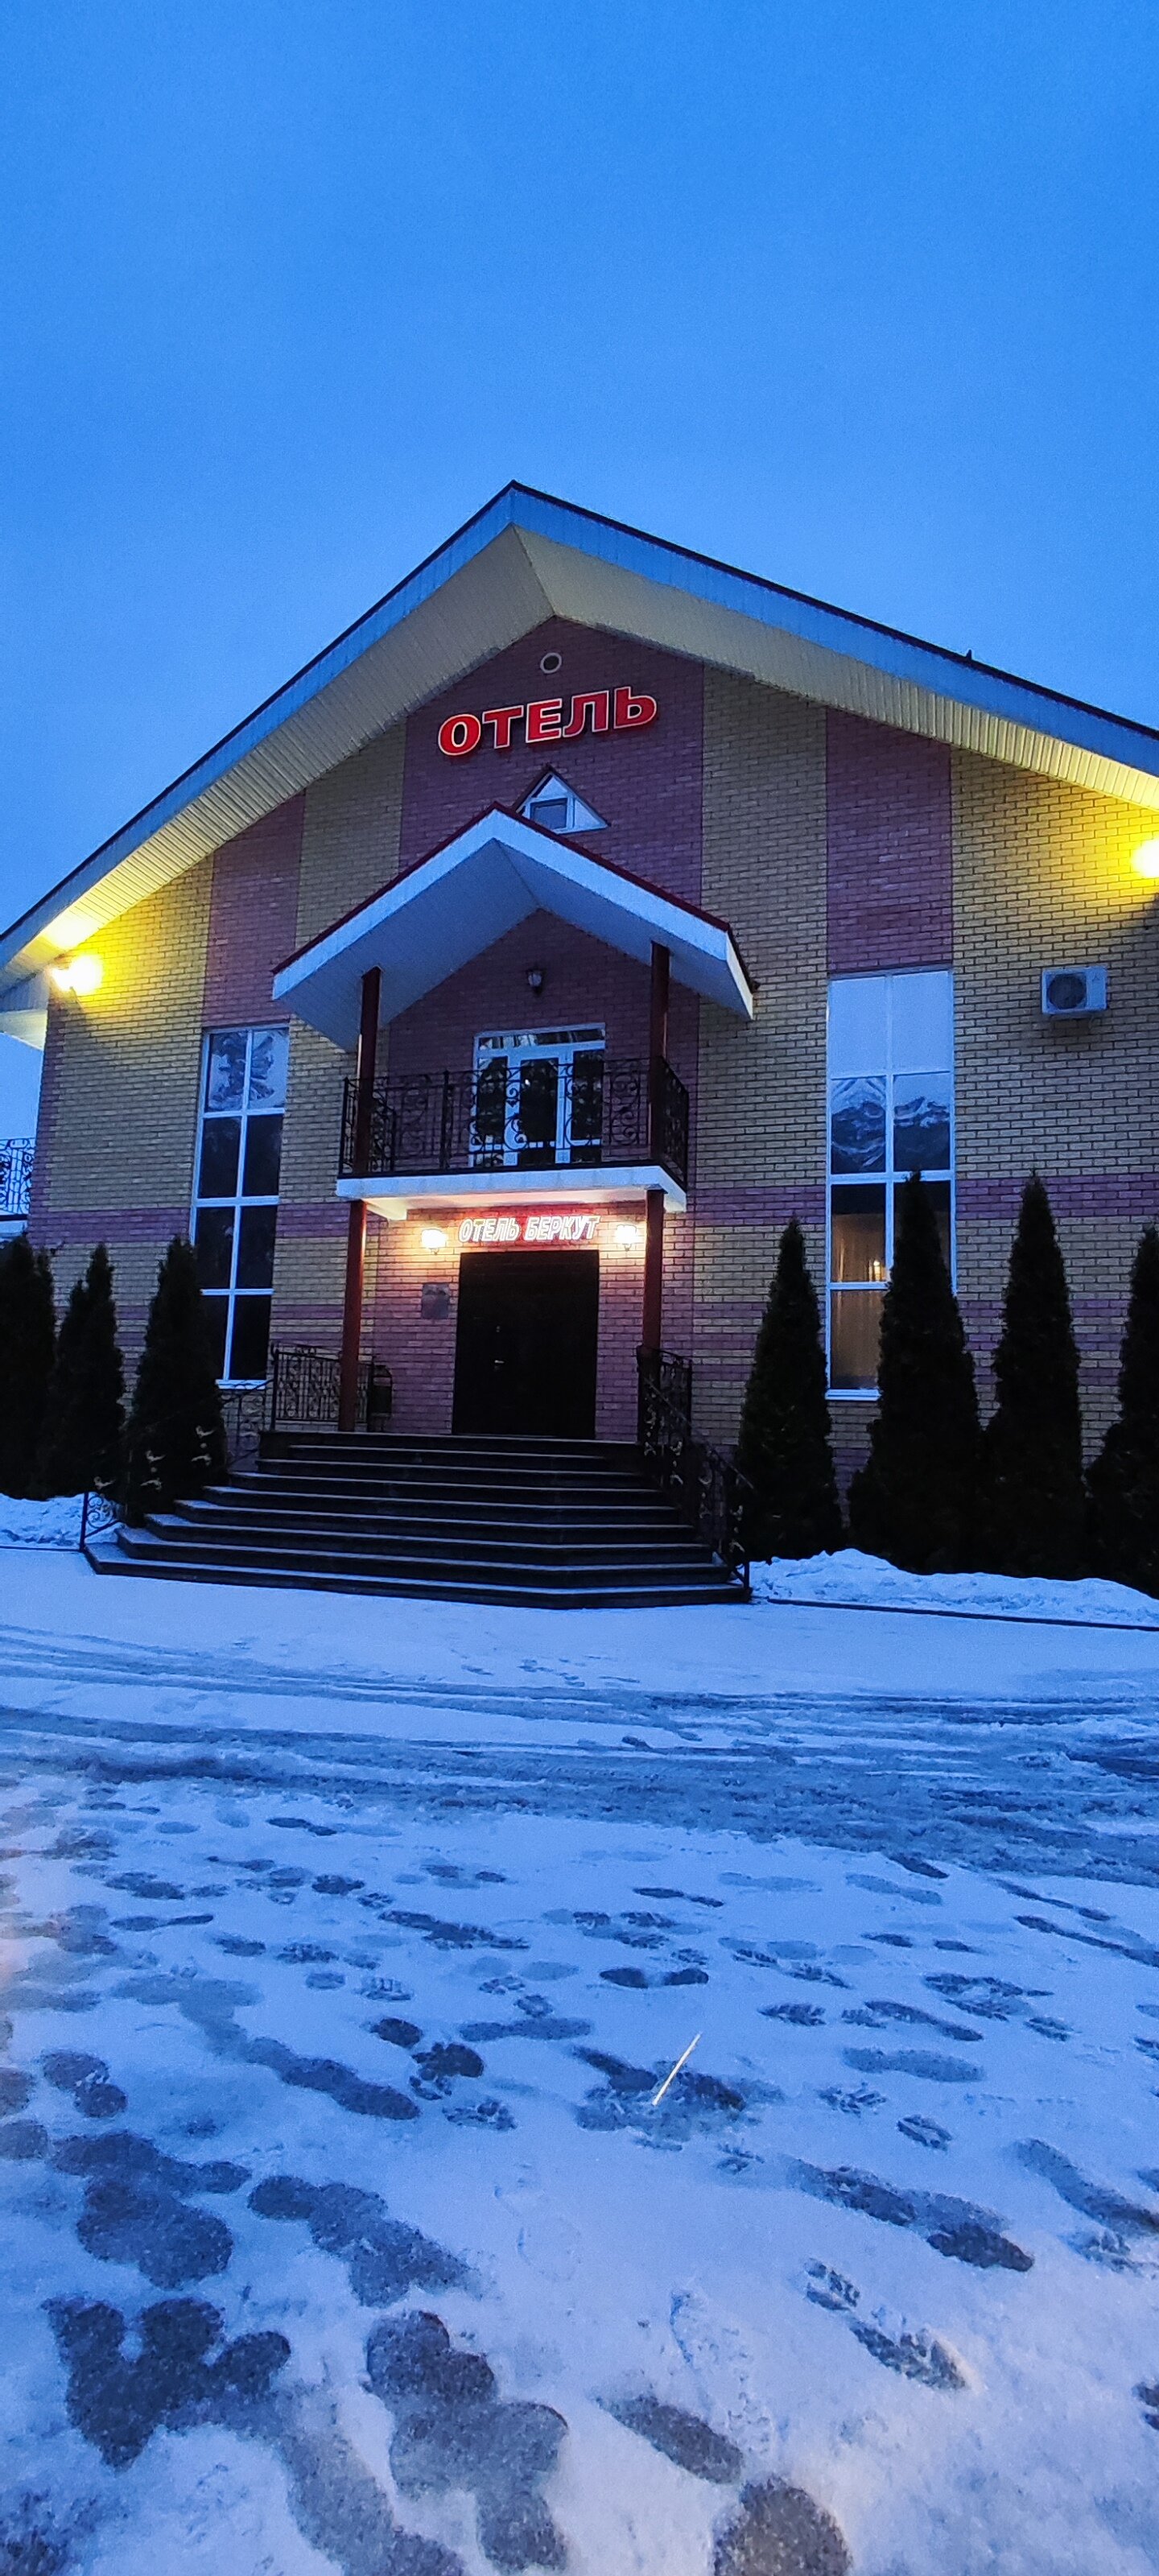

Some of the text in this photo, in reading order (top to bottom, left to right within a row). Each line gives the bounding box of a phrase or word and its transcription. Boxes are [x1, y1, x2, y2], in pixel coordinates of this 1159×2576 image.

[438, 687, 657, 756] ОТЕЛЬ
[459, 1216, 600, 1242] ОТЕЛЬ БЕРКУТ
